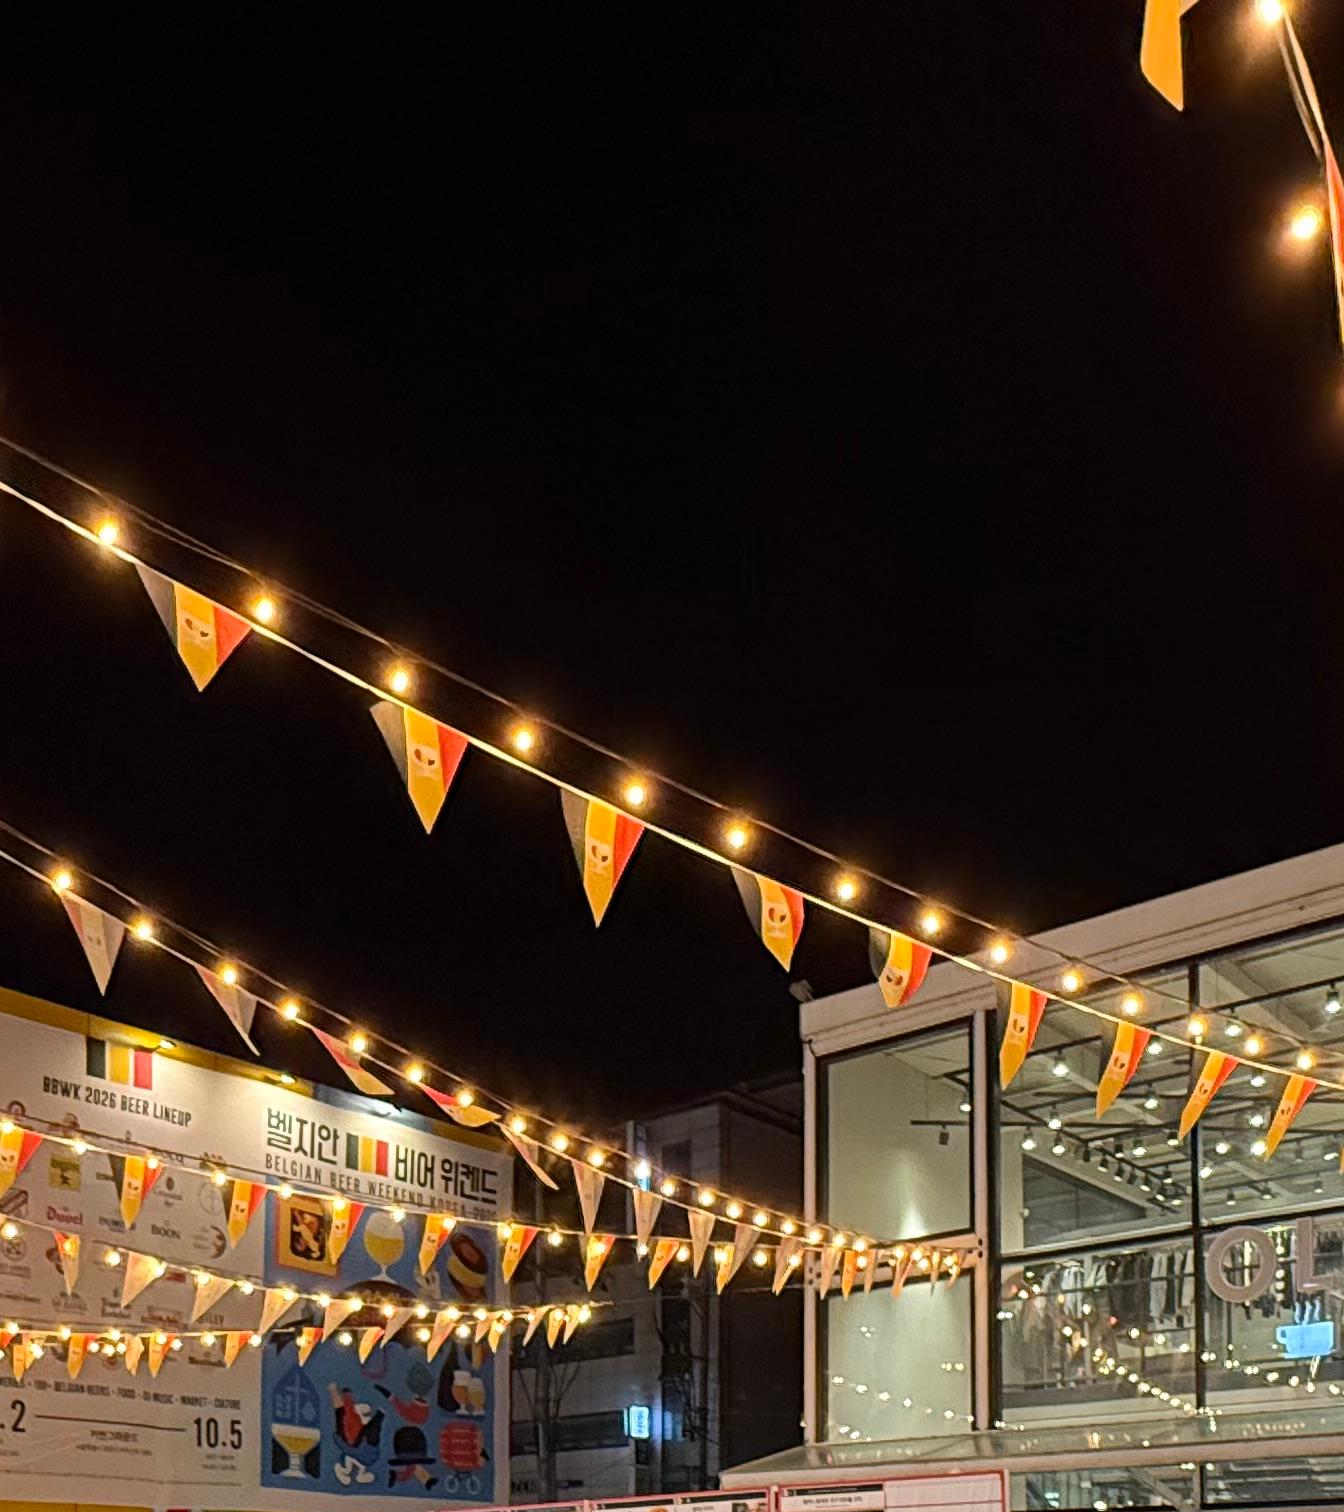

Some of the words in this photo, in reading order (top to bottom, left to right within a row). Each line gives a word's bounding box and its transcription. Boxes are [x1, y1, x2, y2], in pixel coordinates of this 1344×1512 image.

[42, 1075, 81, 1101] BBWK
[84, 1086, 117, 1109] 2026
[120, 1095, 150, 1117] BEER
[153, 1102, 192, 1128] LINEUP
[265, 1152, 322, 1184] BELGIAN
[329, 1167, 361, 1194] BEER
[367, 1179, 424, 1208] WEEKEND
[266, 1106, 340, 1166] 벨지안
[394, 1143, 436, 1190] 비어
[440, 1157, 498, 1205] 위켄드
[151, 1223, 181, 1240] BOON
[193, 1416, 243, 1450] 10.5
